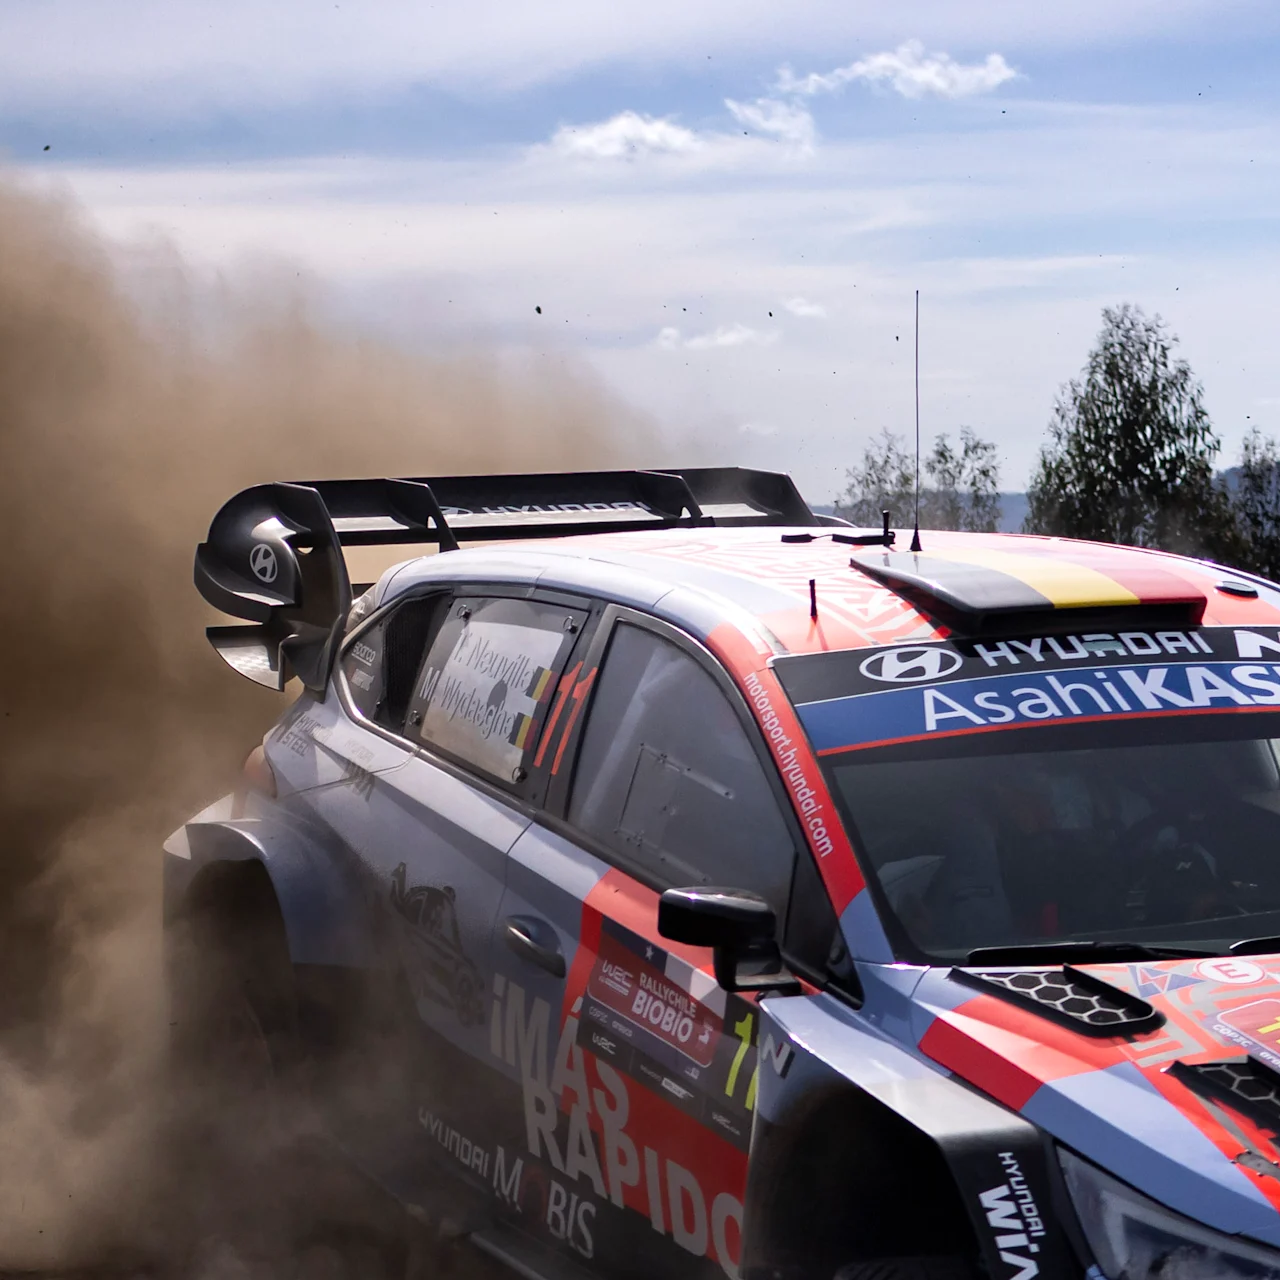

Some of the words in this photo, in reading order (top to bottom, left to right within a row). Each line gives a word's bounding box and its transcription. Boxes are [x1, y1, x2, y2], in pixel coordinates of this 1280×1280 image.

[973, 631, 1214, 667] HYUNDAI
[419, 666, 440, 703] M.
[282, 732, 310, 757] STEEL
[533, 660, 598, 776] 11
[744, 671, 834, 858] motorsport.hyundai.com
[997, 1151, 1047, 1237] HYUNDAI
